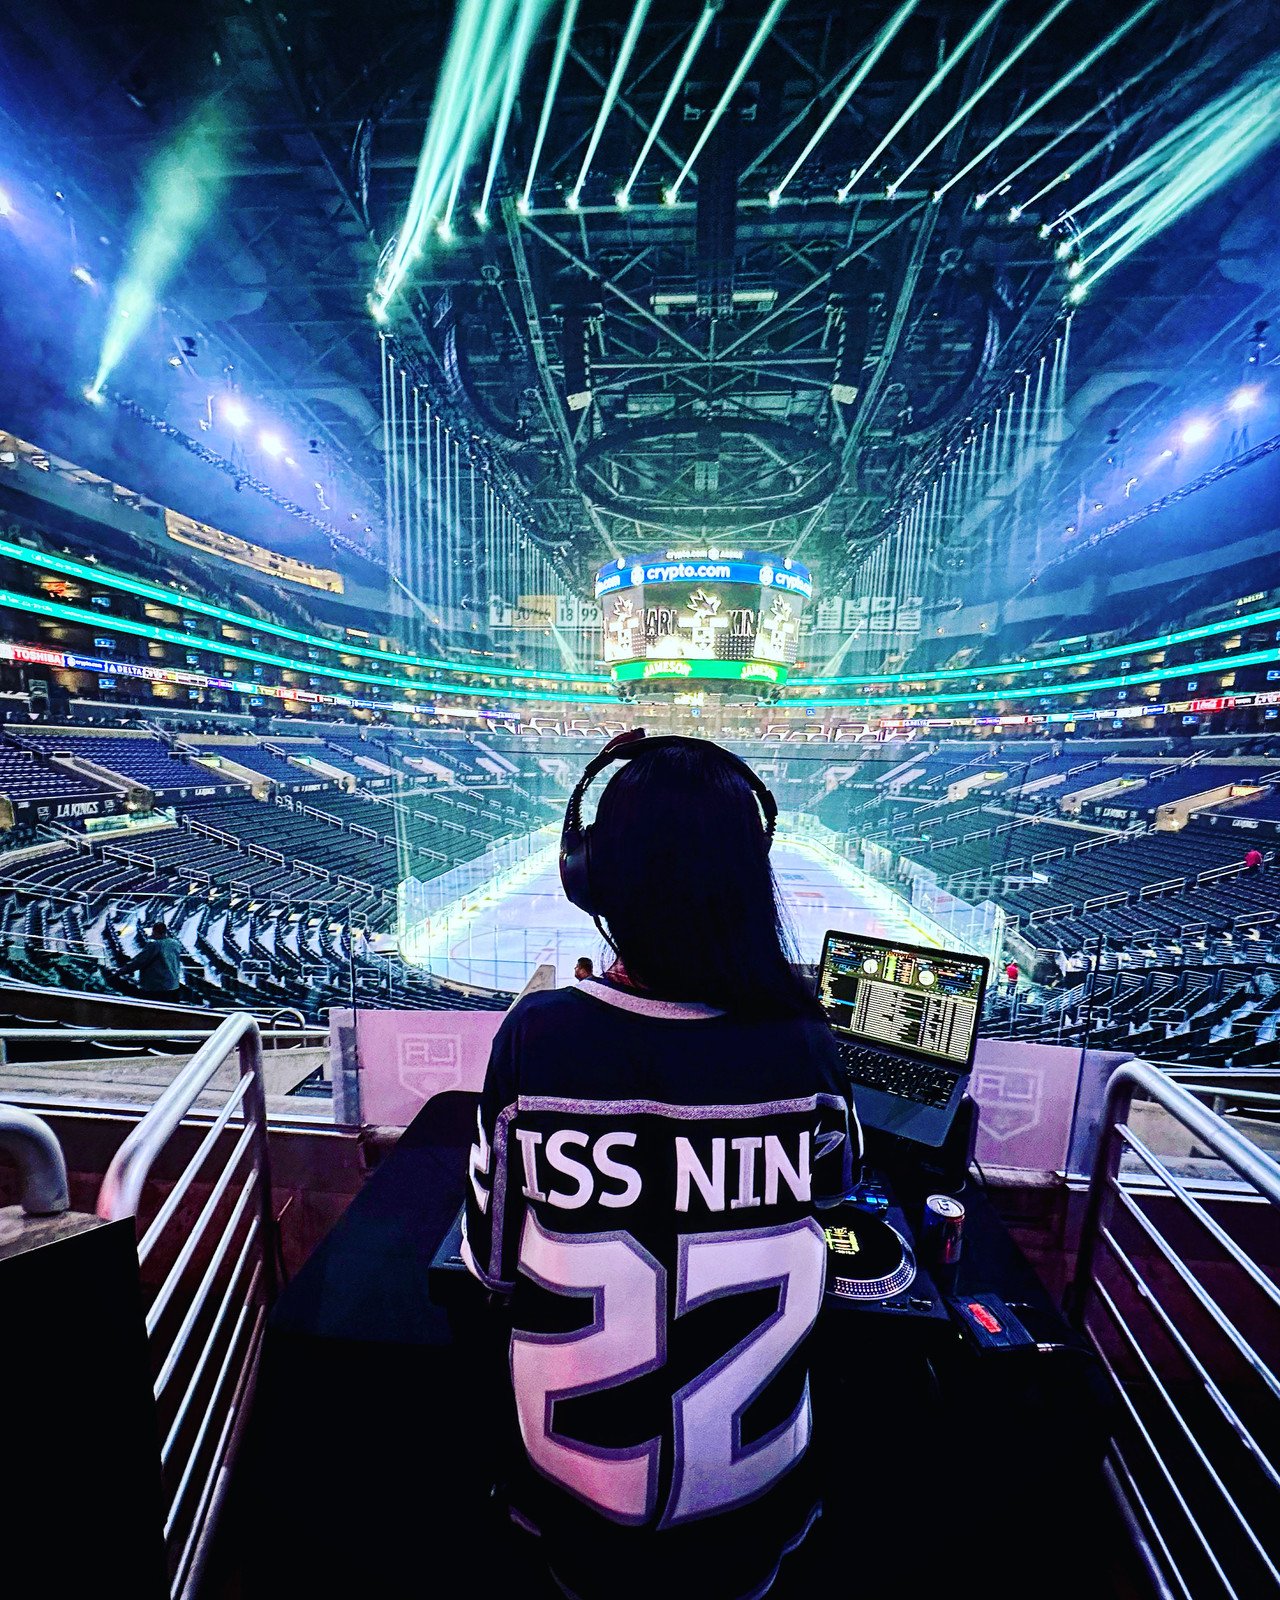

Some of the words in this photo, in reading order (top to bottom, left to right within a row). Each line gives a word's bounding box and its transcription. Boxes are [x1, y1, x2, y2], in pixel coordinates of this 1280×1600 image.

[646, 563, 731, 581] crypto.com
[560, 608, 573, 621] 18
[580, 608, 597, 621] 99
[15, 648, 61, 664] TOSHIBA
[116, 664, 142, 675] DELTA
[643, 661, 692, 678] JAMESON
[56, 804, 70, 818] LA
[70, 801, 99, 817] KINGS
[508, 1204, 828, 1531] 22
